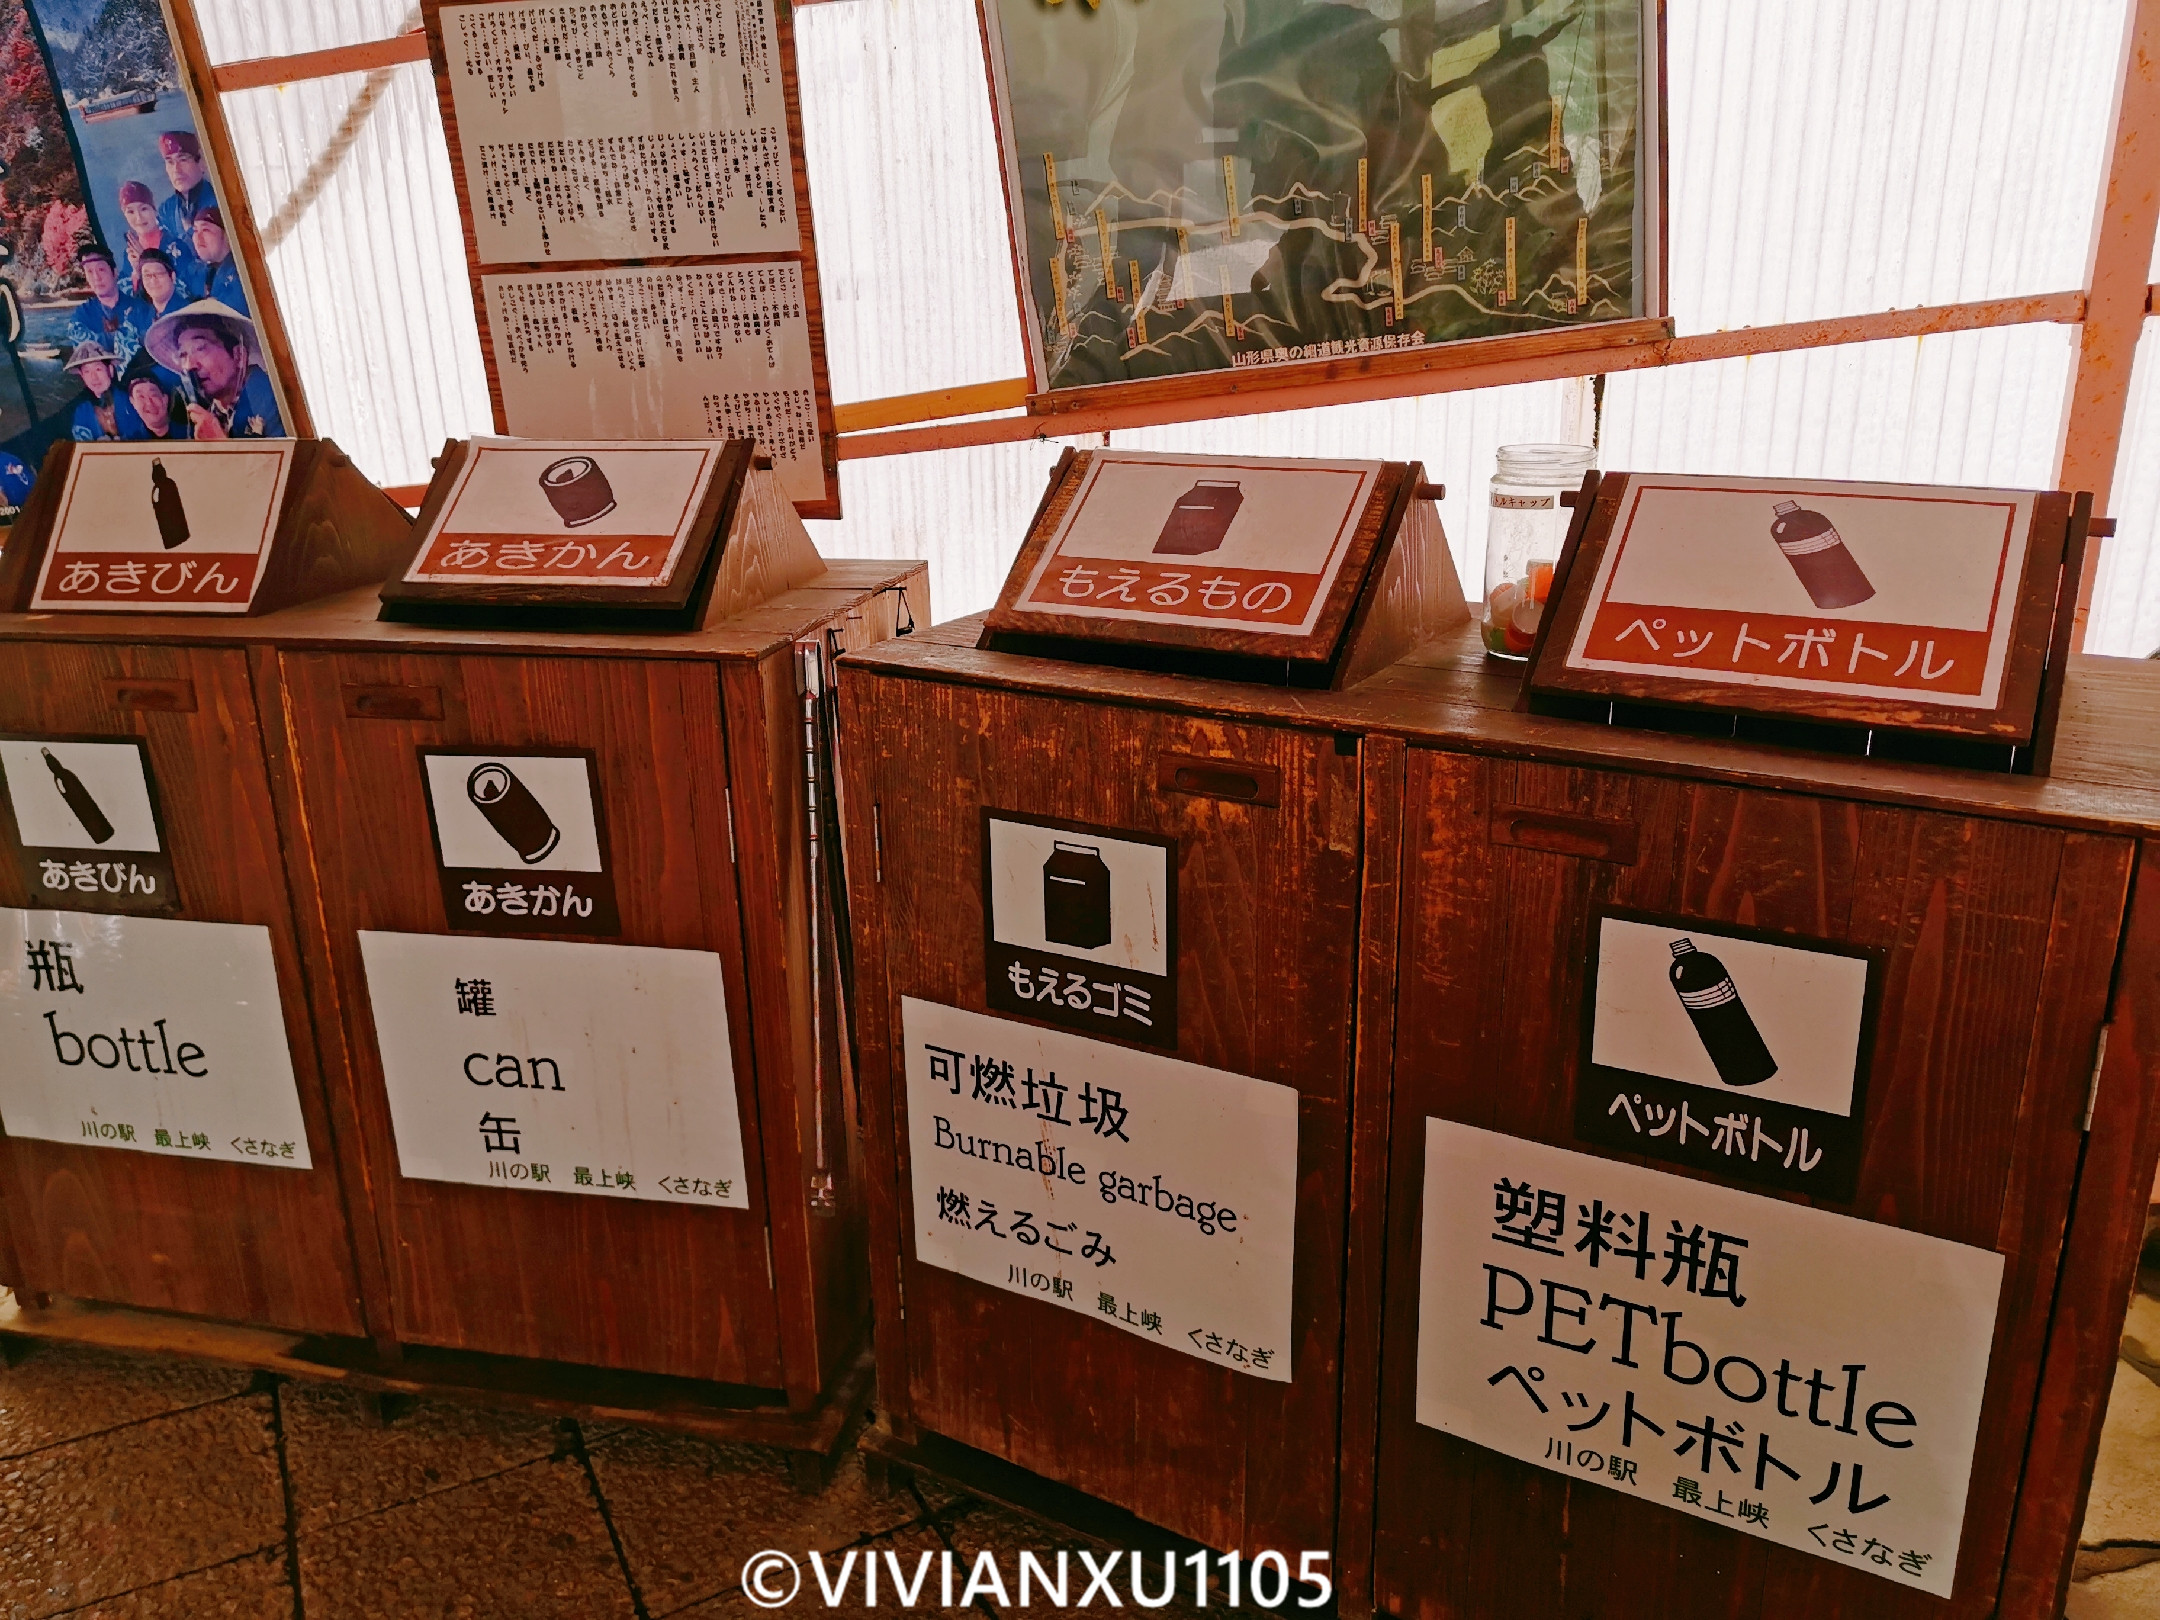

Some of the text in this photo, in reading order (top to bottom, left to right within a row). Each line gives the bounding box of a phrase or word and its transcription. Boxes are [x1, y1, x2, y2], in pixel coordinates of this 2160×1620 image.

[1232, 330, 1425, 367] 山形県奥の細道観光資源保存会
[59, 559, 239, 596] あきびん
[440, 539, 652, 571] あきかん
[1058, 562, 1294, 615] もえるもの
[1614, 617, 1955, 681] ペットボトル
[40, 859, 157, 896] あきびん
[463, 881, 593, 918] あきかん
[25, 939, 84, 995] 瓶
[1007, 961, 1153, 1028] もえるゴミ
[455, 978, 498, 1018] 罐
[42, 1010, 210, 1080] bottle
[463, 1050, 566, 1092] can
[925, 1043, 1131, 1144] 可燃垃圾
[80, 1120, 297, 1160] 川の駅 最上峡 くさなぎ
[478, 1112, 523, 1155] 缶
[1608, 1091, 1823, 1173] ペットボトル
[488, 1159, 733, 1199] 川の駅 最上峡 くさなぎ
[933, 1116, 1239, 1236] Burnable garbage
[936, 1186, 1118, 1269] 燃えるごみ
[1493, 1178, 1750, 1308] 塑料瓶
[1007, 1263, 1275, 1370] 川の駅 最上峡 くさなぎ
[1480, 1263, 1918, 1449] PETbottle
[1487, 1364, 1891, 1516] ペットボトル
[1545, 1436, 1933, 1578] 川の駅 最上峡 くさなぎ
